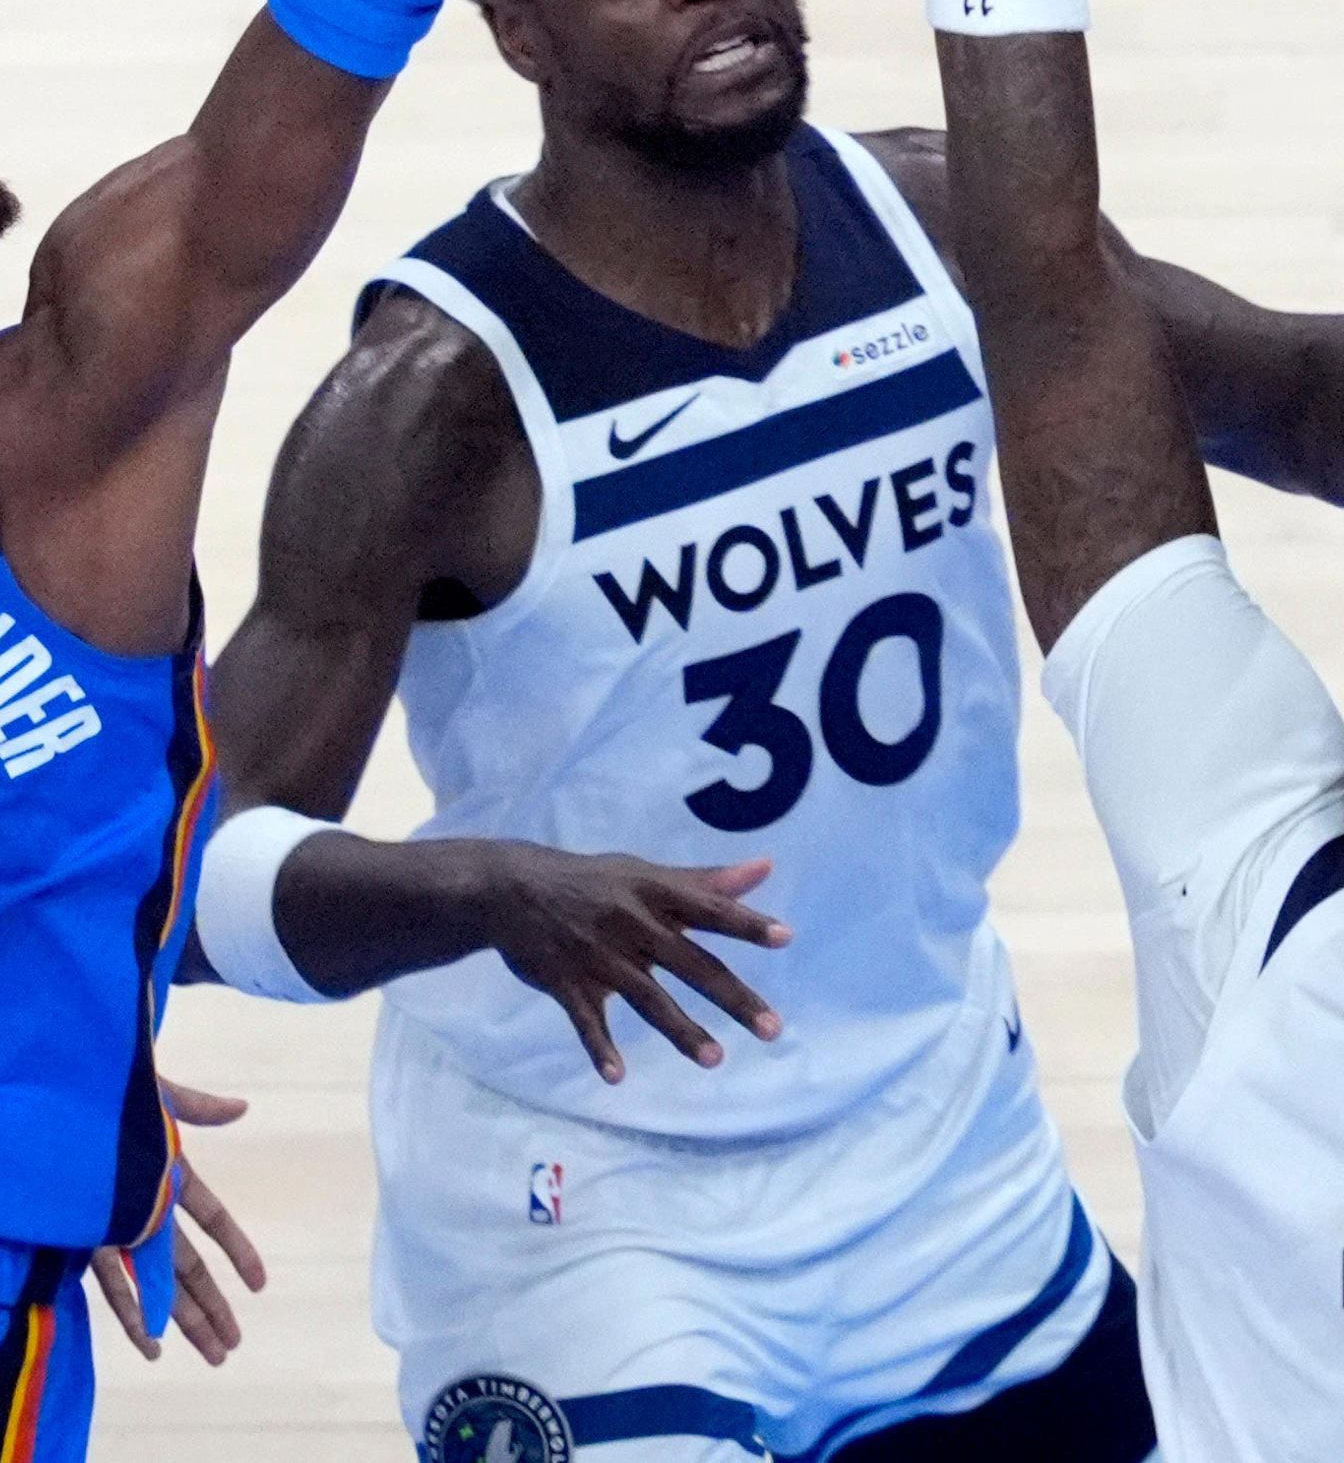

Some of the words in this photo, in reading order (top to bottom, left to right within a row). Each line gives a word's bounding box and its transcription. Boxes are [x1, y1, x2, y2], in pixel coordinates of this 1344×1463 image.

[851, 322, 929, 365] sezzle
[592, 440, 976, 645] WOLVES
[683, 592, 944, 833] 30
